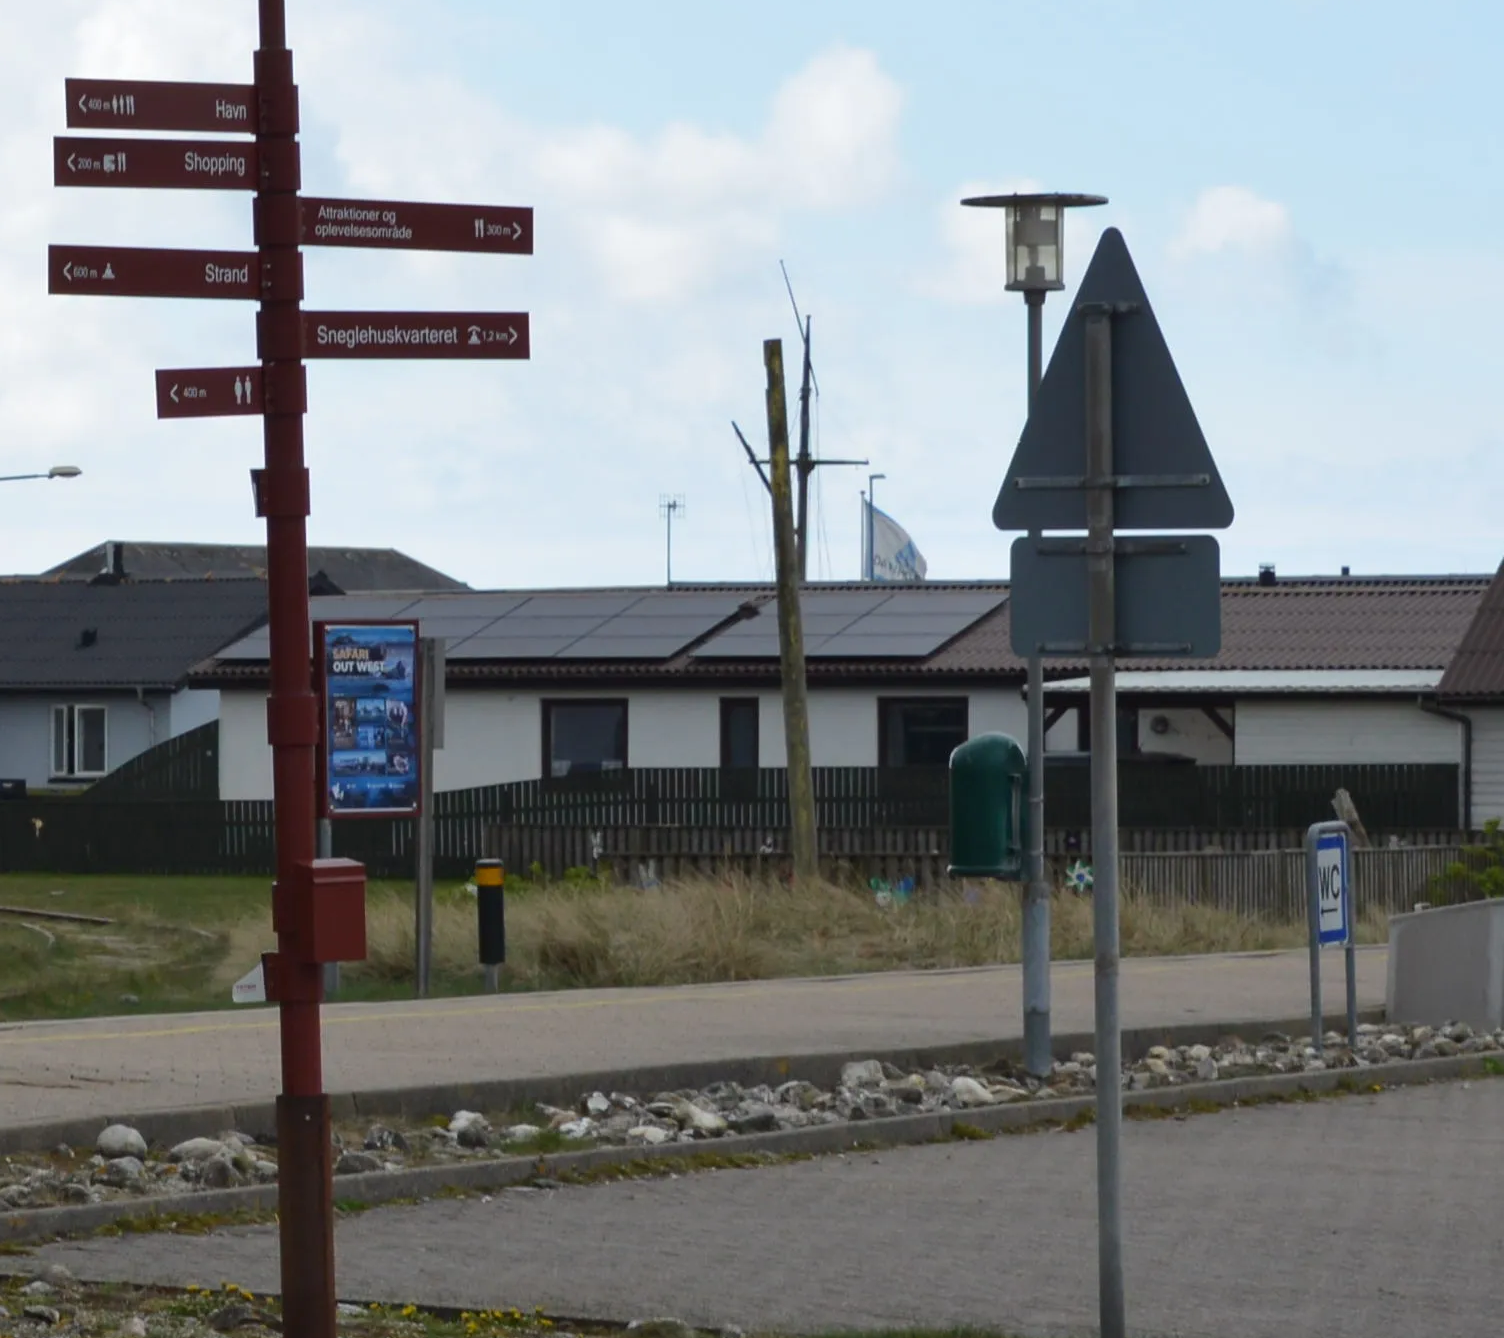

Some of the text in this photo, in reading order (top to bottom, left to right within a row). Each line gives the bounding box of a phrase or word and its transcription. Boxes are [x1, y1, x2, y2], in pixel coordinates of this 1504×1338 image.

[216, 100, 247, 120] Havn
[77, 158, 92, 169] 200
[184, 151, 245, 177] Shopping
[318, 205, 396, 225] Attraktioner og
[315, 223, 412, 239] oplevelsesområde
[205, 263, 248, 283] Strand
[317, 325, 458, 349] Sneglehuskvarteret
[496, 331, 508, 342] km
[333, 647, 369, 660] SAFARI
[333, 660, 384, 674] OUT WEST
[1318, 864, 1340, 900] WC
